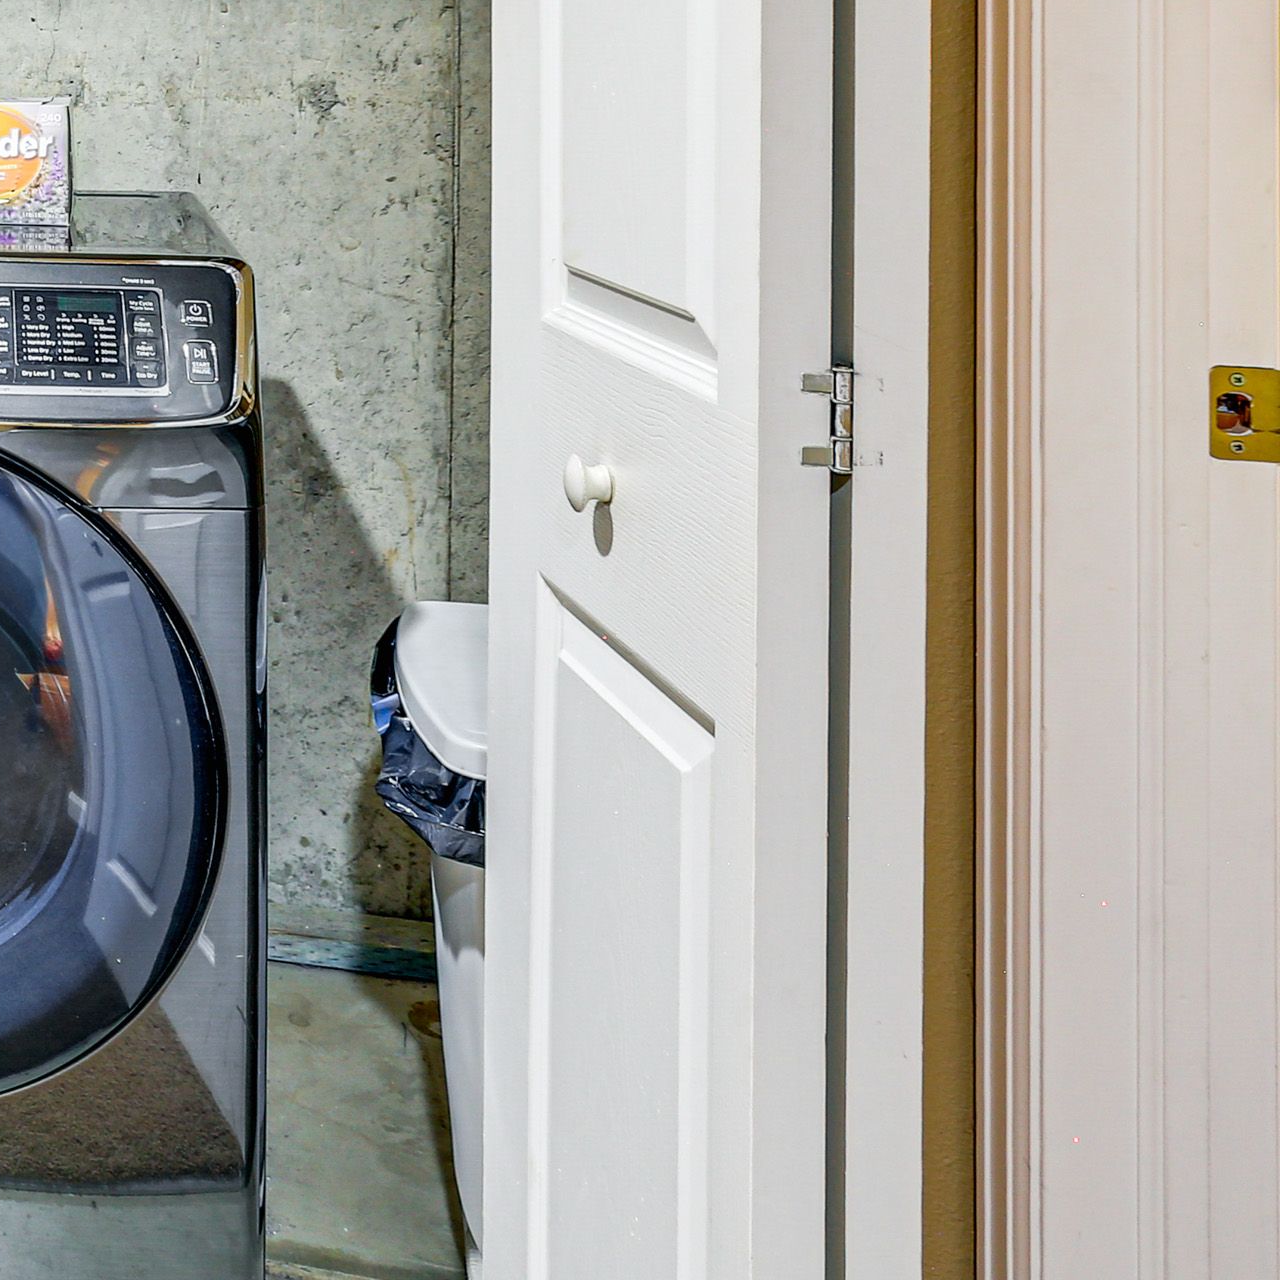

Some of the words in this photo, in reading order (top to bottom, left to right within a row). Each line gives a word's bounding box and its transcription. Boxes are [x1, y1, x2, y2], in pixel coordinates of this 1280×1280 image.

[139, 300, 154, 308] Cycle
[22, 369, 33, 377] Dry
[33, 369, 49, 377] Level
[147, 372, 158, 380] Dry
